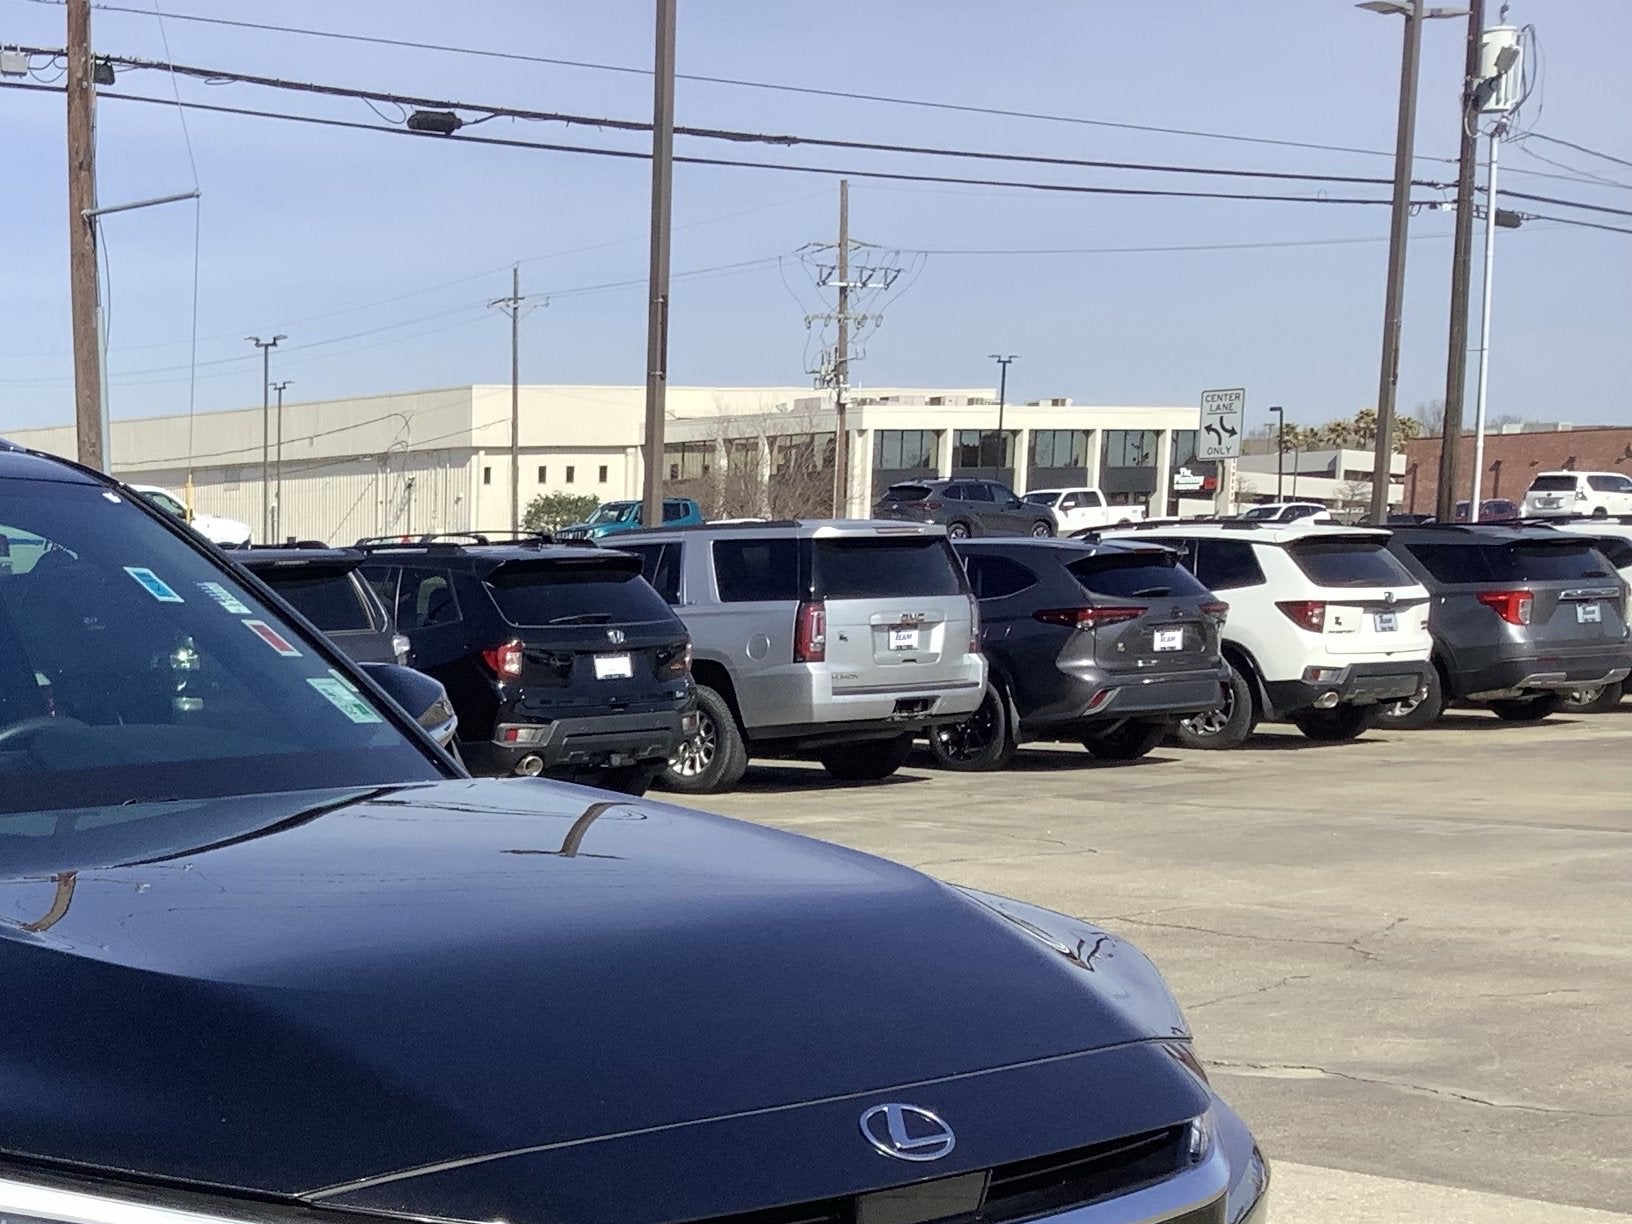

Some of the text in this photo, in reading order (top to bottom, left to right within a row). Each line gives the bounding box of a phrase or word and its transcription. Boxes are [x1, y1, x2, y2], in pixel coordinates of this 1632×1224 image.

[1205, 392, 1241, 403] CENTER
[1210, 403, 1235, 412] LANE
[1207, 446, 1232, 456] ONLY
